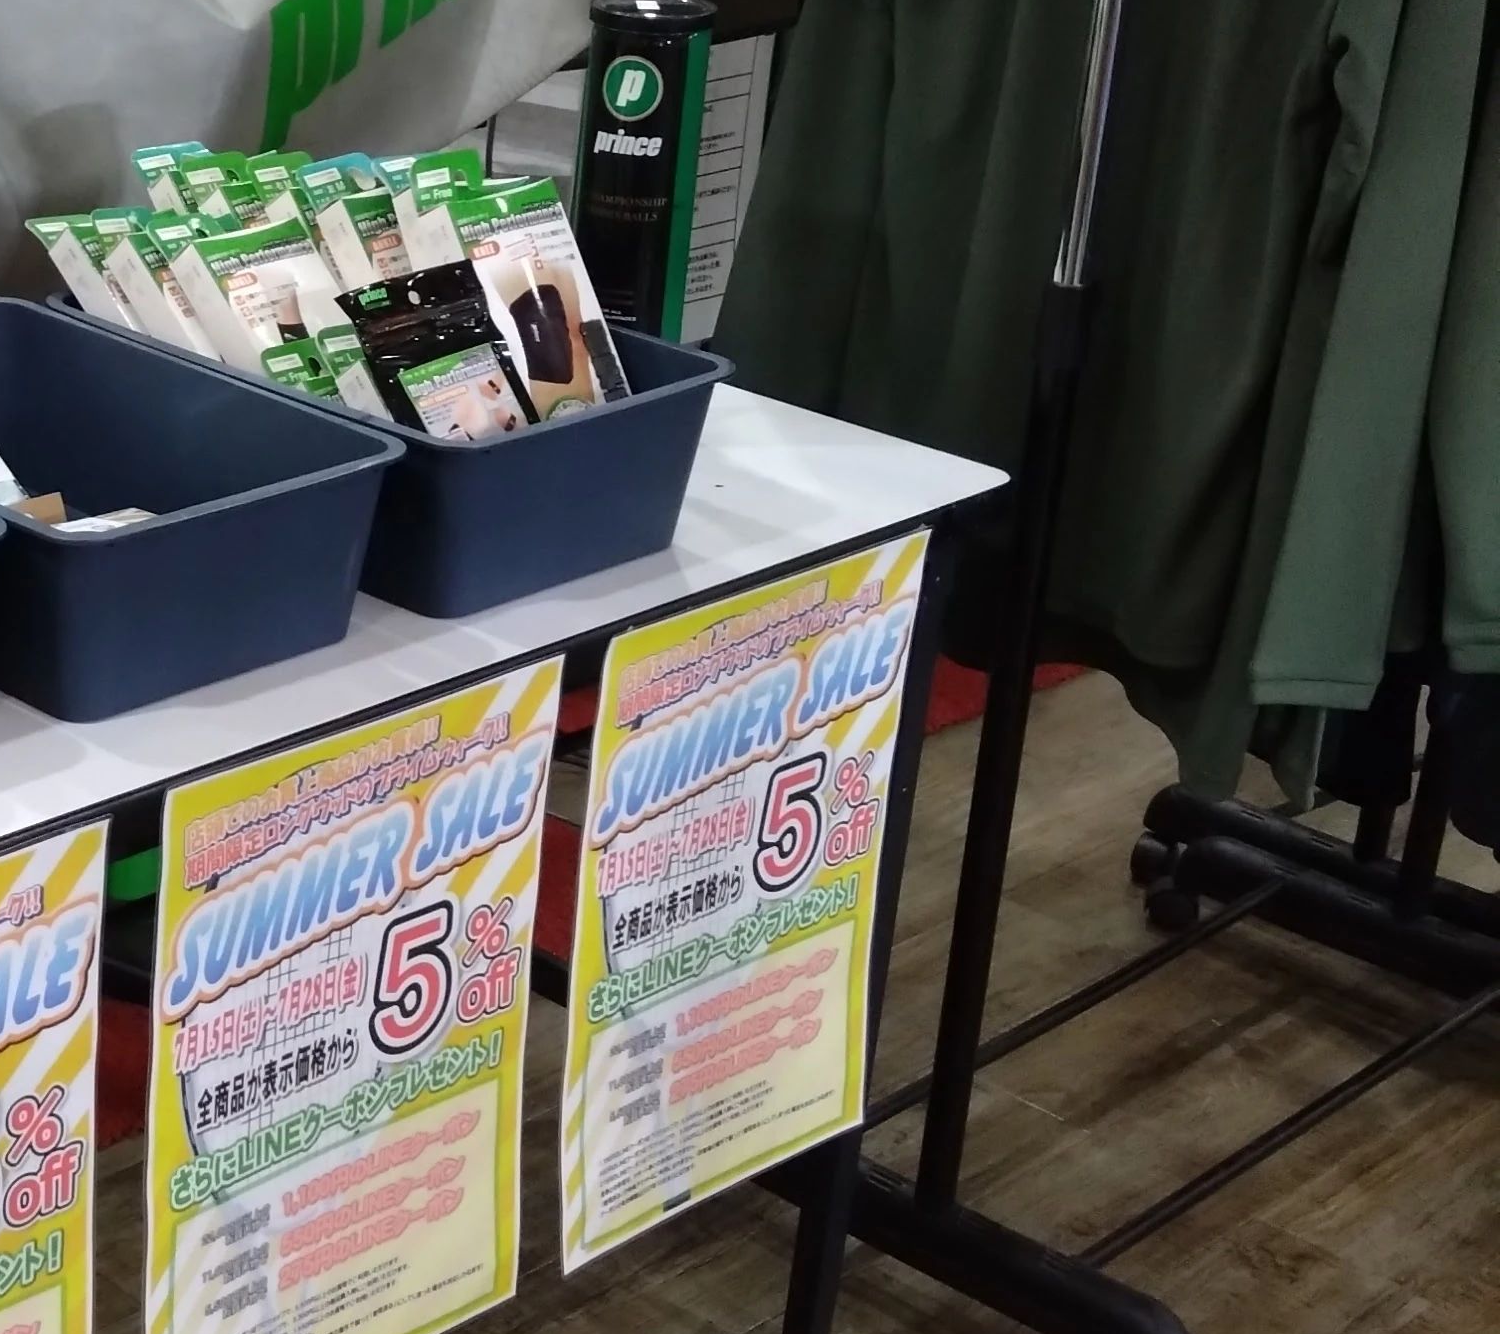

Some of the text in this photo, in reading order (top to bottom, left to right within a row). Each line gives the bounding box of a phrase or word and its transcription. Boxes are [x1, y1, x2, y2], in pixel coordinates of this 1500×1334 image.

[593, 129, 663, 157] prince
[597, 682, 794, 836] SUMMER
[800, 609, 908, 721] SALE
[169, 738, 544, 1008] SUMMER SALE
[753, 750, 827, 894] 5
[823, 797, 879, 867] off
[369, 898, 454, 1056] 5
[455, 947, 522, 1023] off
[196, 1027, 358, 1130] 全商品が表示価格から
[3, 1146, 83, 1227] off
